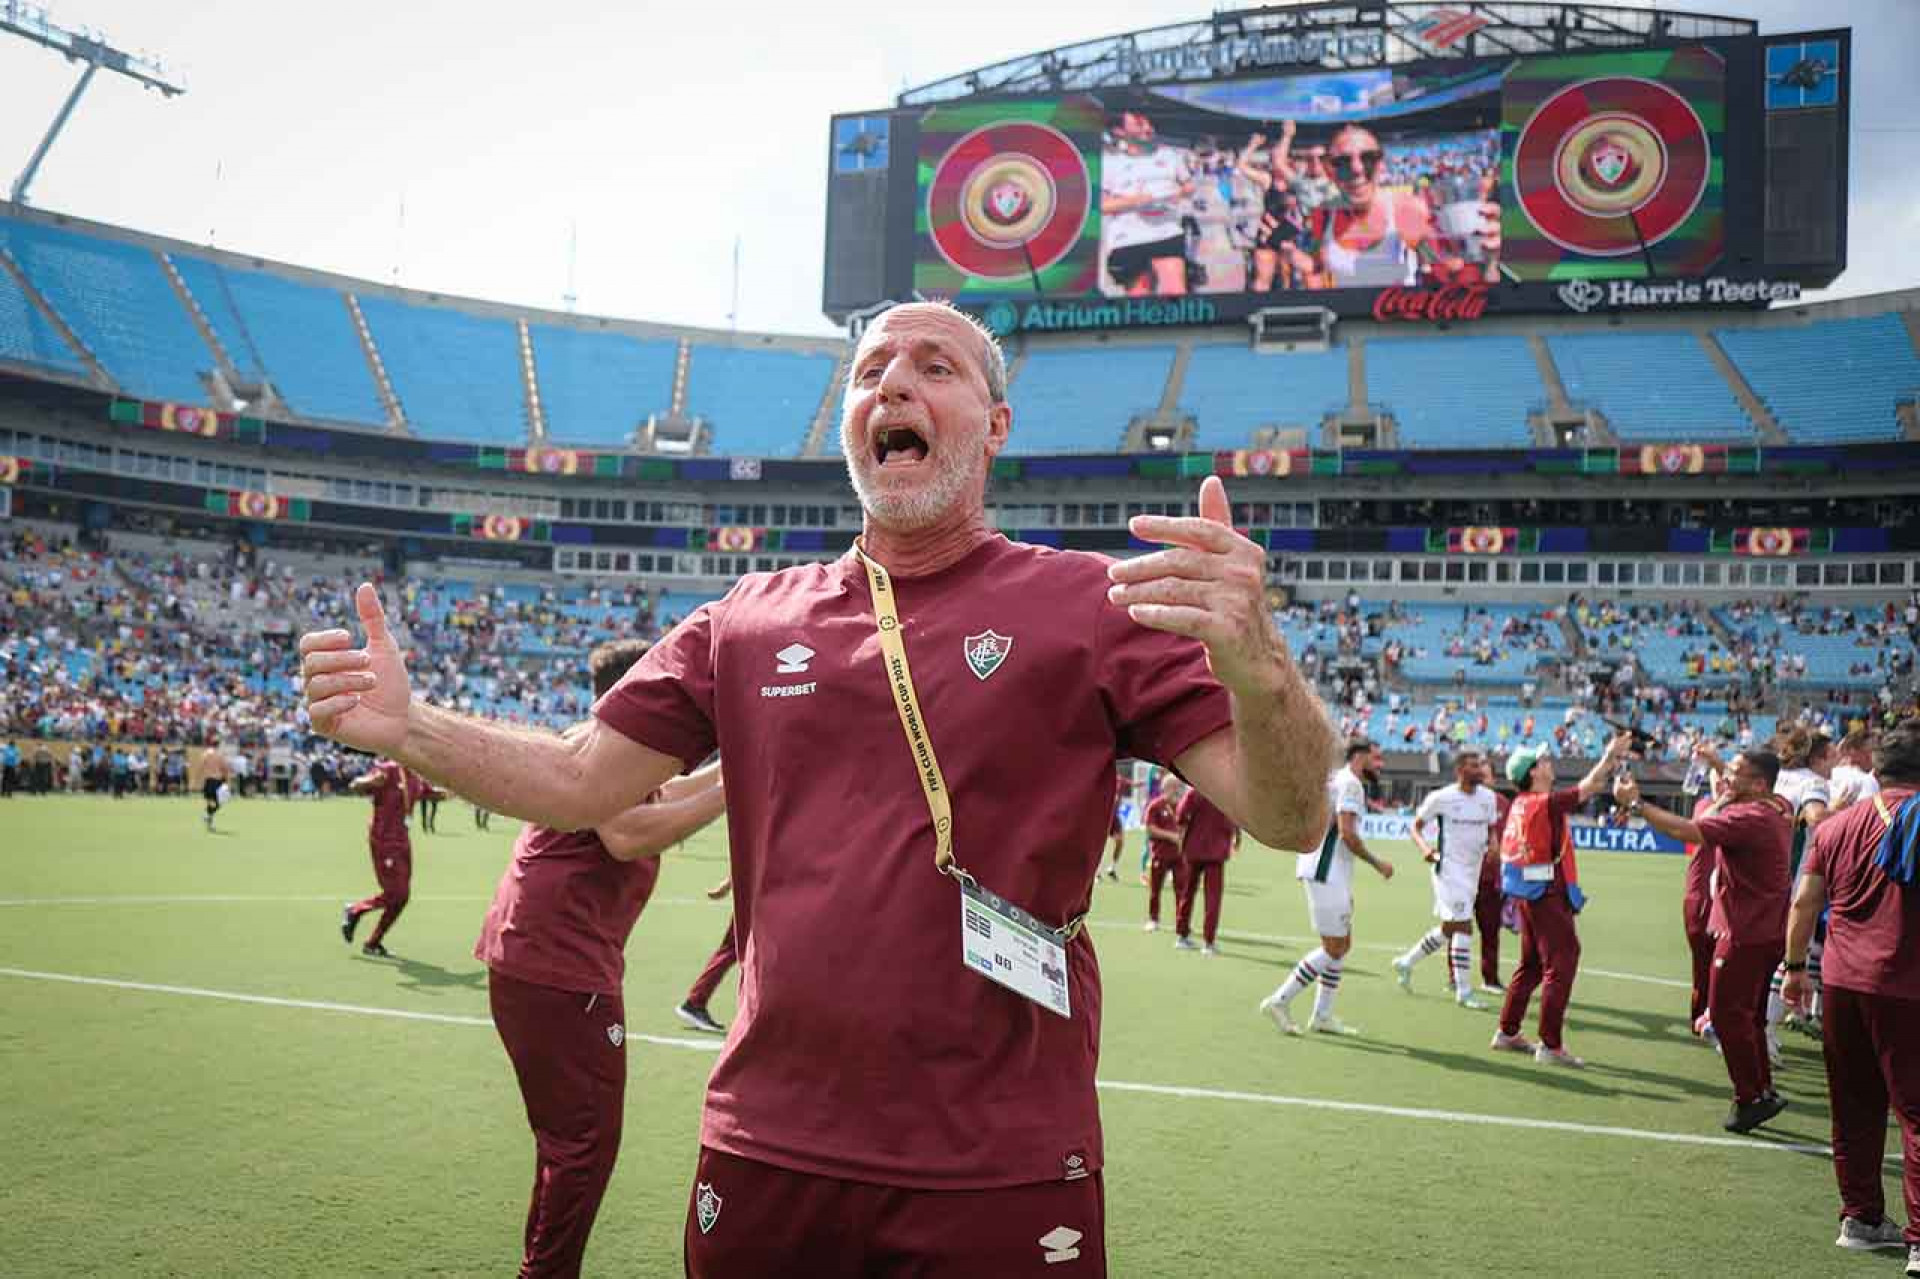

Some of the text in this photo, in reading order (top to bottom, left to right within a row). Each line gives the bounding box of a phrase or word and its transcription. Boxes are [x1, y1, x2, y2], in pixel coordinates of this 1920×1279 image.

[1609, 278, 1801, 306] Harris Teeter
[1023, 299, 1215, 329] Atrium Health
[761, 682, 816, 697] SUPERBET
[898, 683, 910, 702] CUP
[904, 703, 921, 741] WORLD
[917, 742, 931, 768] CLUB
[926, 769, 939, 792] FIFA
[1364, 819, 1411, 836] RICA
[1574, 827, 1657, 851] ULTRA
